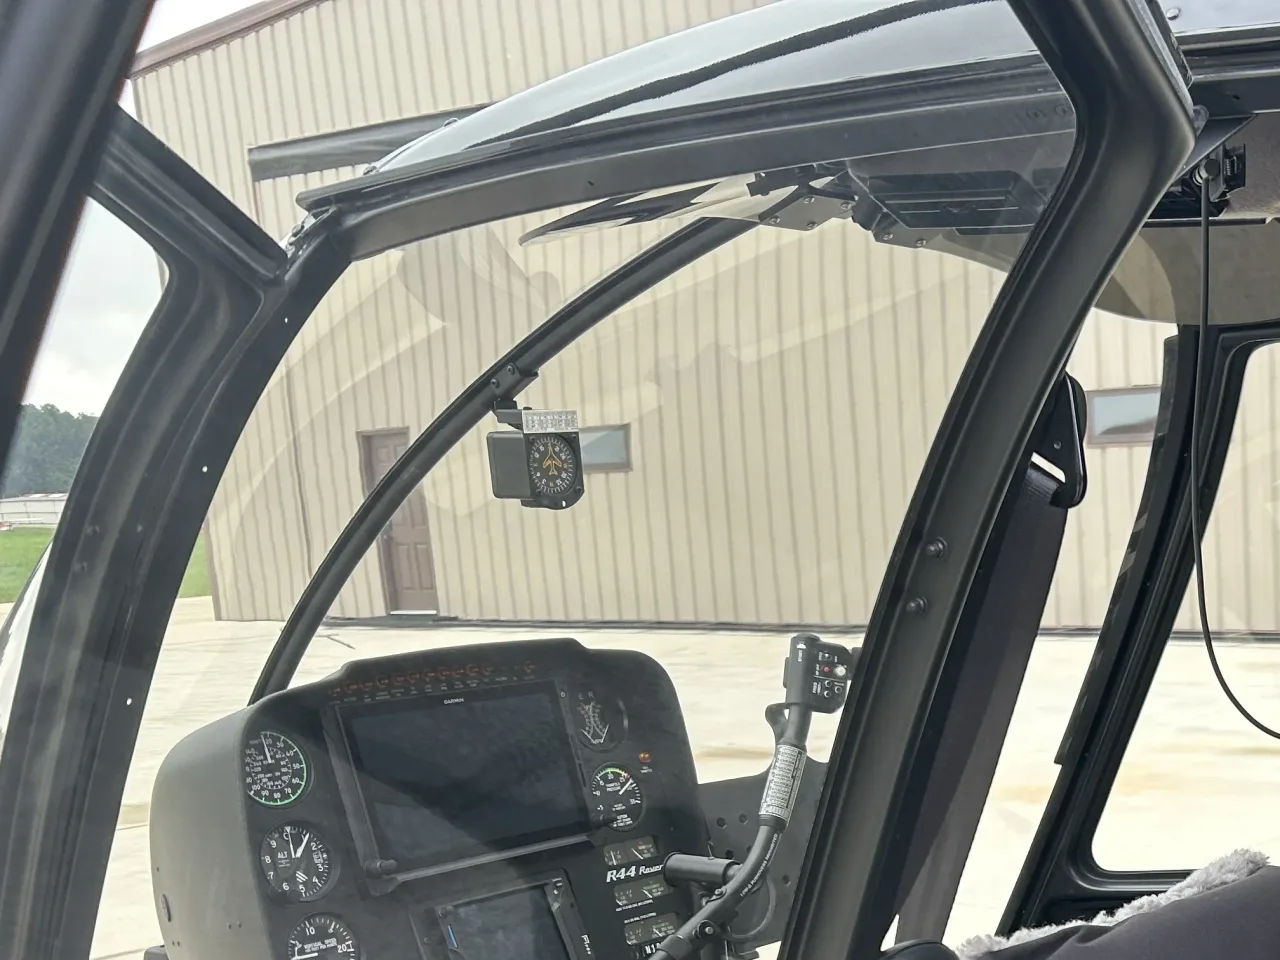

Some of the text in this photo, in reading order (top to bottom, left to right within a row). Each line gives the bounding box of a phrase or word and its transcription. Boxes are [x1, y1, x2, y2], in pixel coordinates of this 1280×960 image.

[270, 840, 276, 848] 9
[311, 842, 317, 850] 2
[268, 871, 274, 879] 7
[606, 866, 636, 883] R44
[283, 882, 289, 890] 6
[299, 884, 305, 892] 5
[306, 927, 315, 935] 10
[337, 944, 347, 953] 20
